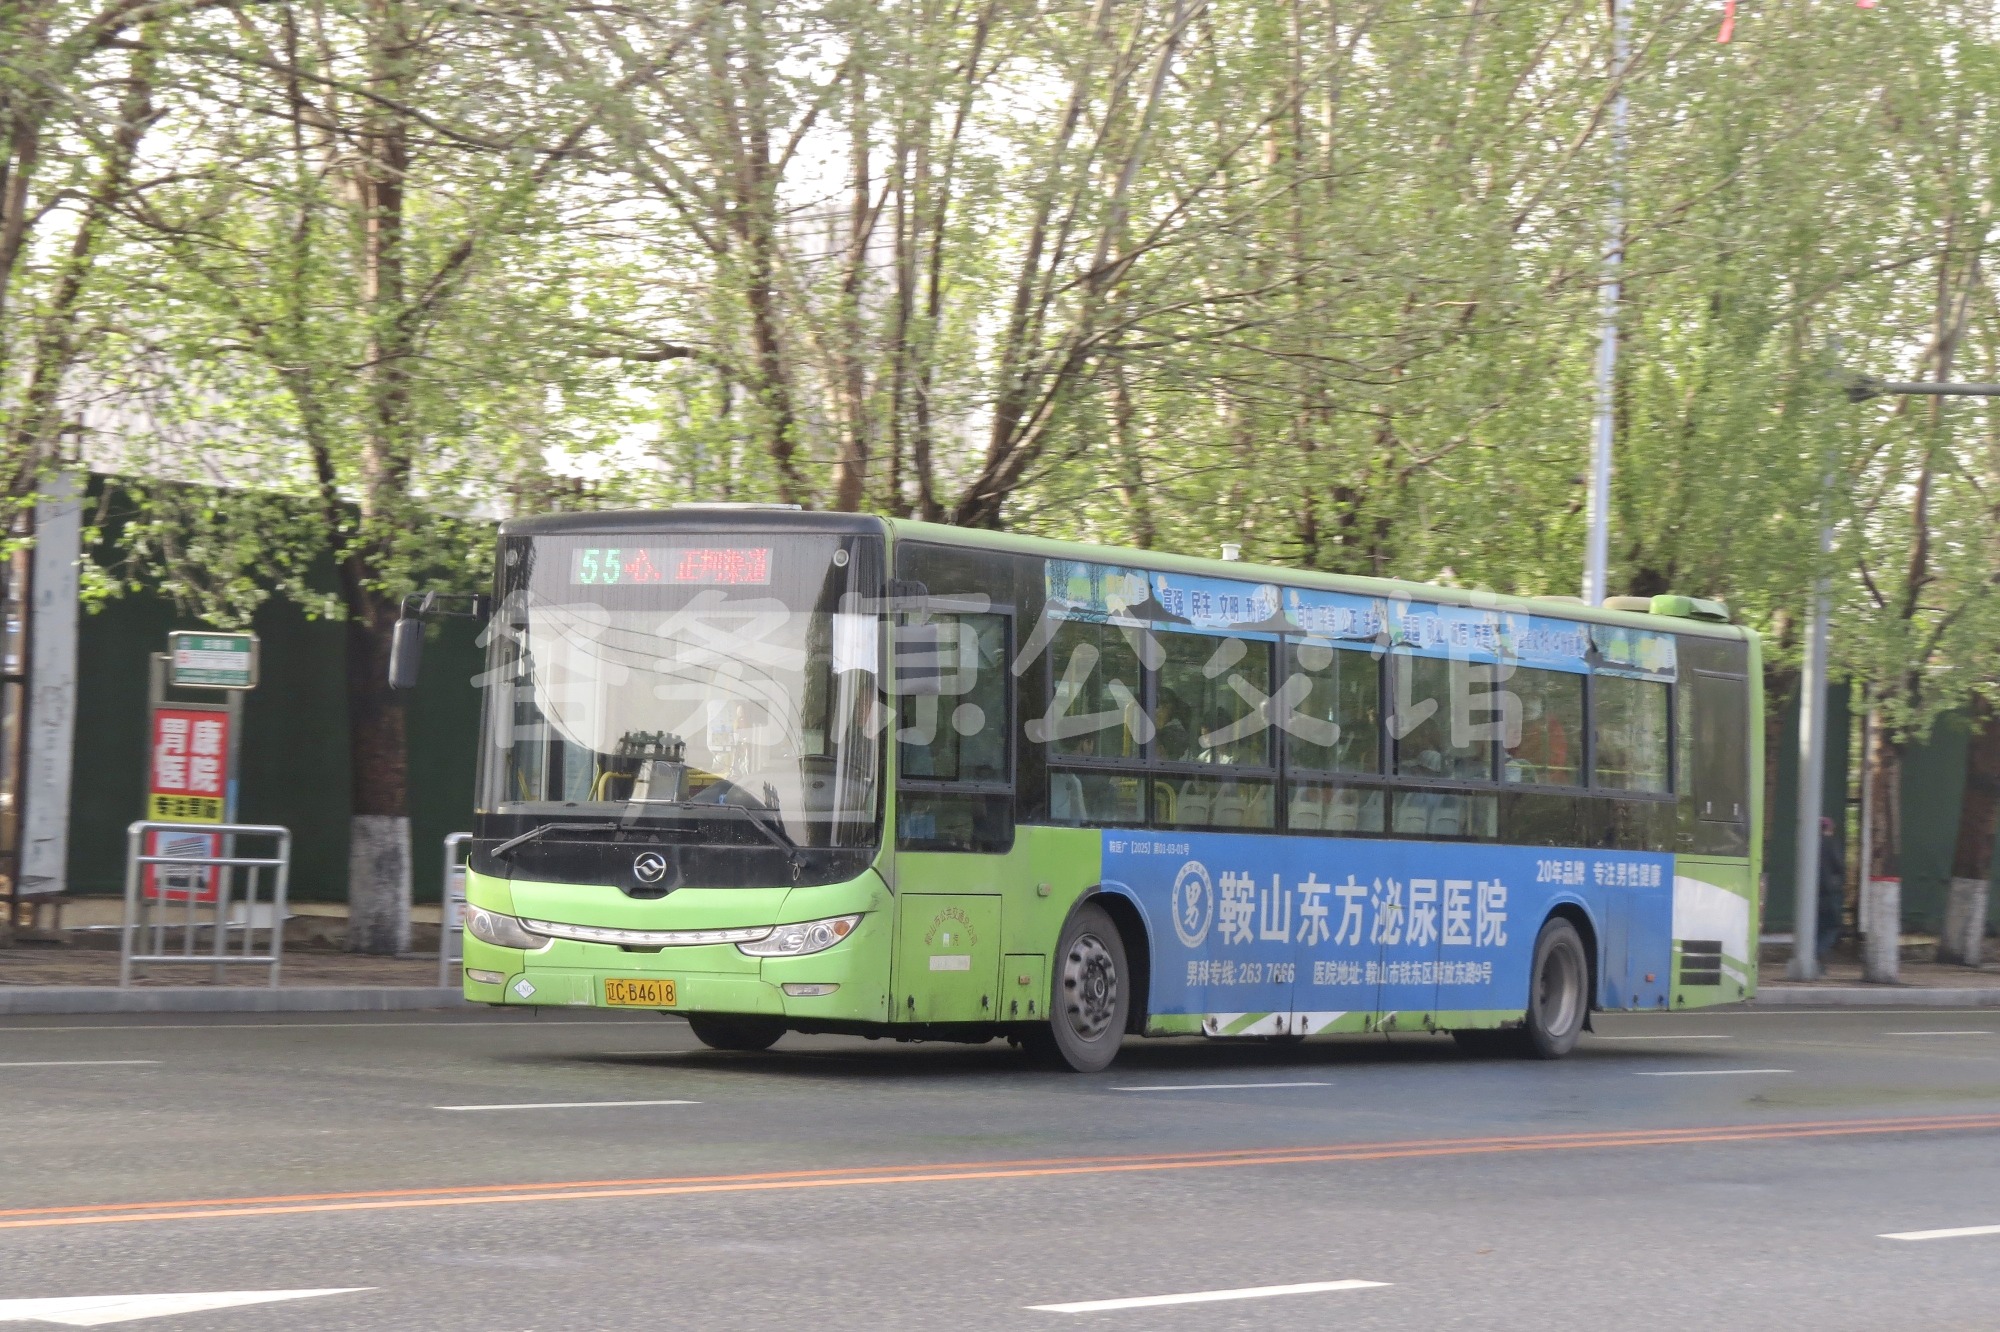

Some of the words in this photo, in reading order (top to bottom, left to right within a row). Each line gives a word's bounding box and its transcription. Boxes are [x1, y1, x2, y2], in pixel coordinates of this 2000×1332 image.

[579, 549, 621, 584] 55
[1191, 591, 1212, 619] 民主
[1219, 594, 1239, 621] 文明
[1536, 859, 1585, 885] 20年品牌
[1592, 861, 1662, 887] 专注男性健康
[1217, 870, 1508, 947] 鞍山东方泌尿医院
[518, 984, 533, 993] LNG
